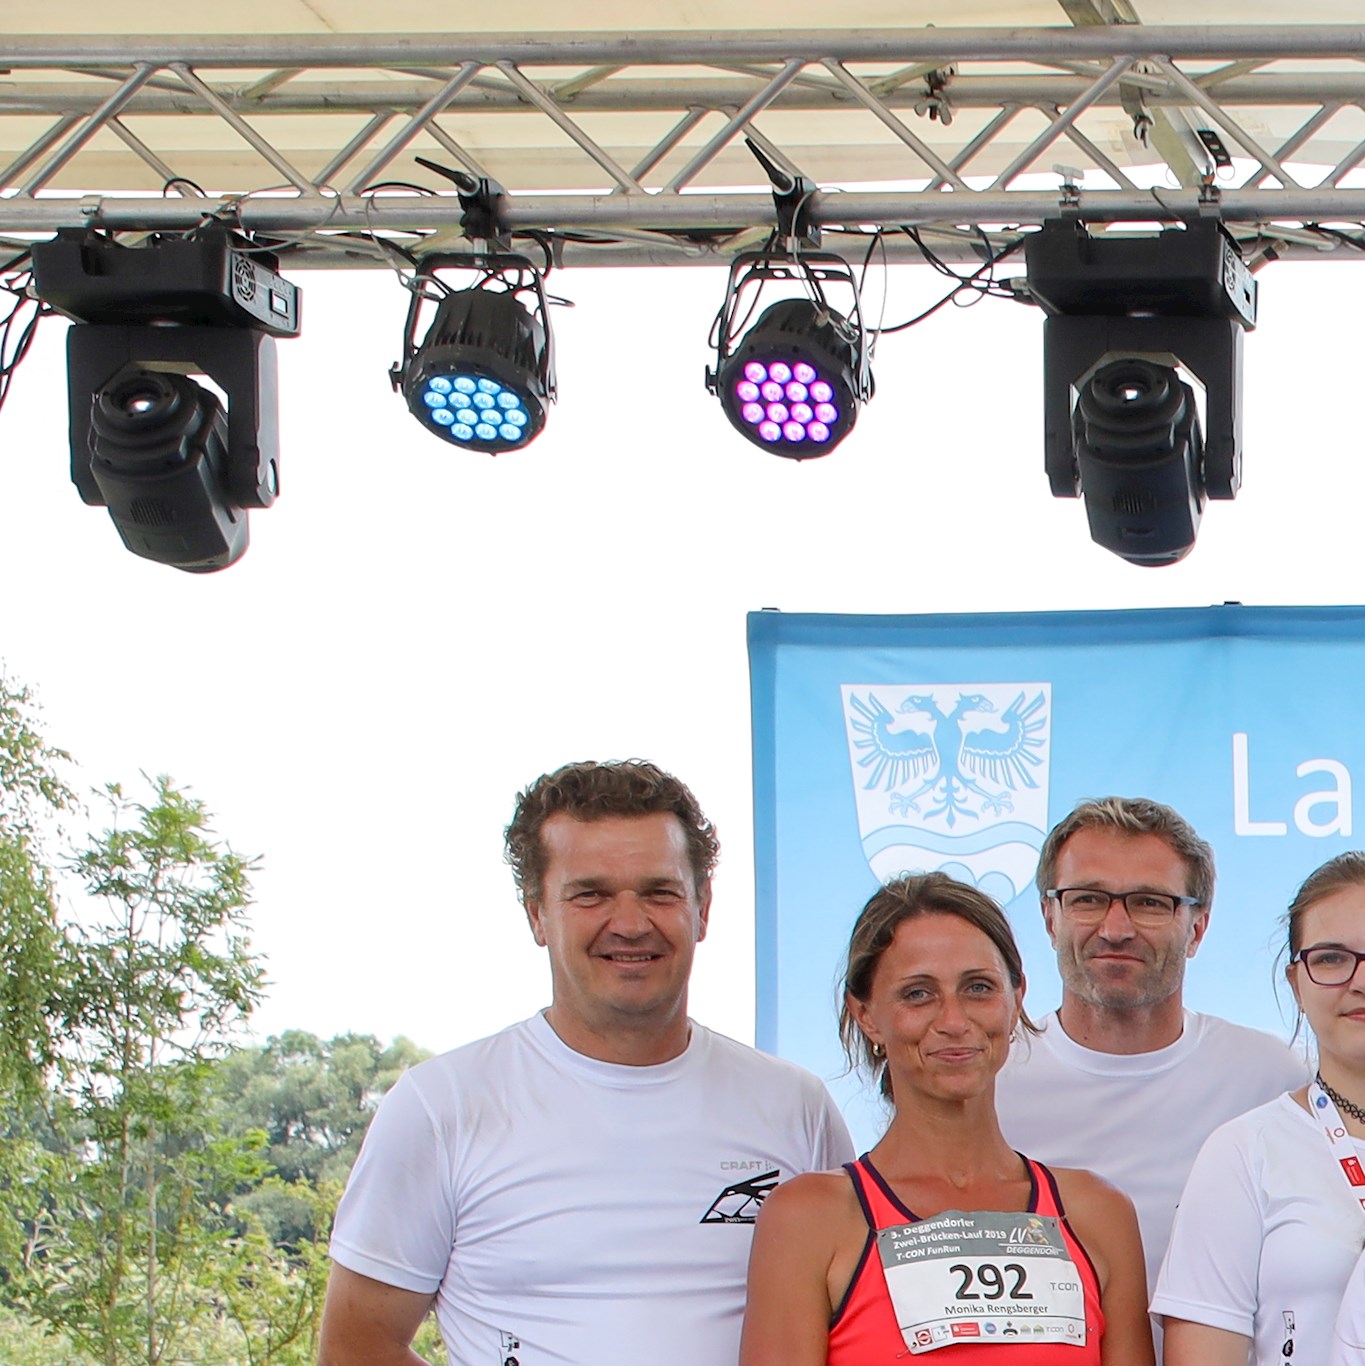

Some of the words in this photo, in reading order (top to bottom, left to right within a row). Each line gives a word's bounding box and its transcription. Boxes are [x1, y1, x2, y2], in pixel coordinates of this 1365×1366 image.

[720, 1161, 763, 1170] CRAFT
[890, 1231, 902, 1240] 3.
[903, 1218, 975, 1237] Deggendorfer
[984, 1229, 1007, 1240] 2019
[1009, 1227, 1027, 1244] LV
[896, 1248, 926, 1261] T-CON
[927, 1244, 961, 1256] FunRun
[949, 1263, 1033, 1300] 292
[945, 1305, 985, 1315] Monika
[987, 1304, 1048, 1315] Rengsberger
